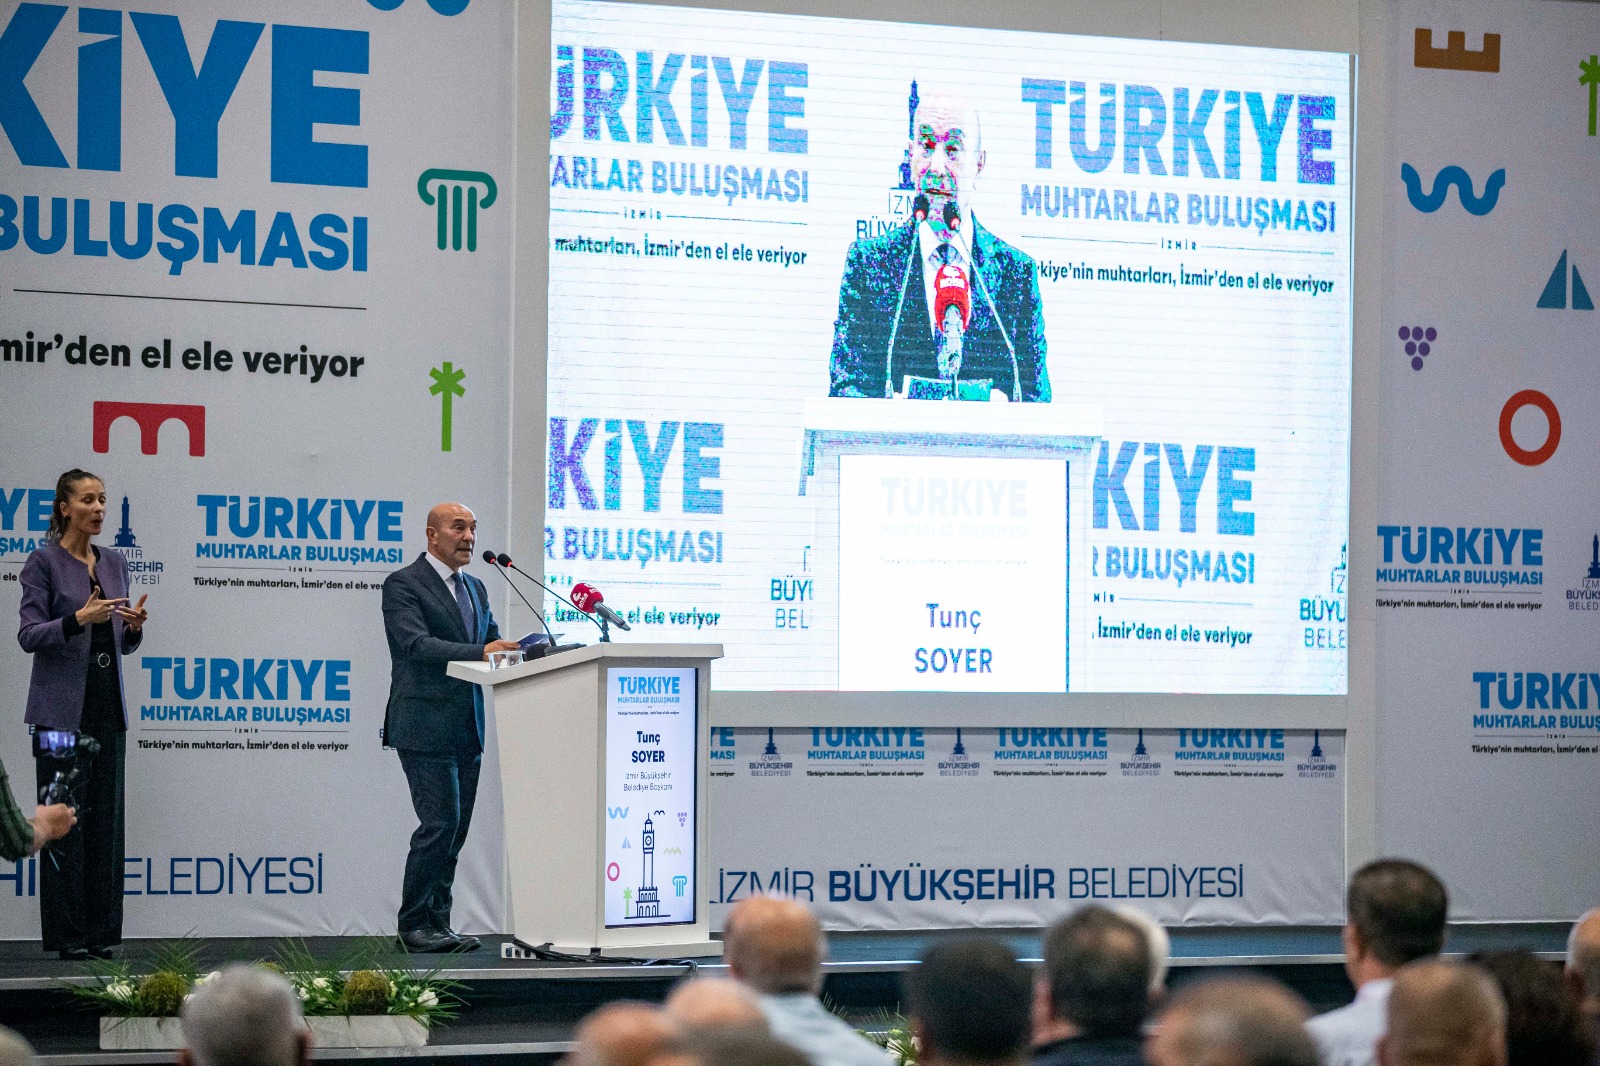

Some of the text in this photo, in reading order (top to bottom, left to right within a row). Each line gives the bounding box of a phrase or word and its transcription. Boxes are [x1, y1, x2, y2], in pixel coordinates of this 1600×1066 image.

[1021, 77, 1336, 185] TÜRKİYE
[550, 155, 808, 206] ARLAR BULUŞMASI
[1021, 184, 1336, 237] MUHTARLAR BULUŞMASI
[716, 243, 728, 260] el
[732, 244, 753, 261] ele
[757, 245, 807, 268] veriyor
[1161, 237, 1197, 250] İZMİR
[1097, 264, 1177, 287] muhtarları,
[1180, 264, 1243, 288] İzmir'den
[1247, 272, 1258, 288] el
[1263, 273, 1283, 290] ele
[1286, 274, 1334, 296] veriyor
[141, 339, 172, 370] el
[181, 341, 233, 374] ele
[243, 345, 364, 384] veriyor
[549, 416, 724, 514] KİYE
[196, 494, 403, 542] TÜRKİYE
[196, 543, 403, 565] MUHTARLAR BULUŞMASI
[564, 526, 723, 569] BULUŞMASI
[1377, 525, 1543, 566] TÜRKİYE
[1106, 545, 1255, 588] BULUŞMASI
[1376, 568, 1543, 588] MUHTARLAR BULUŞMASI
[193, 577, 245, 588] Türkiye'nin
[246, 577, 299, 589] muhtarları,
[301, 577, 343, 589] İzmir'den
[345, 580, 353, 589] el
[355, 581, 368, 590] ele
[1416, 599, 1459, 609] muhtarları,
[1460, 599, 1494, 609] İzmir'den
[1496, 601, 1503, 609] el
[1504, 601, 1515, 609] ele
[1516, 602, 1542, 611] veriyor
[926, 603, 981, 634] Tunç
[1098, 616, 1253, 648] İzmir'den el ele veriyor
[914, 647, 993, 674] SOYER
[141, 656, 351, 701] TÜRKİYE
[617, 676, 680, 694] TÜRKİYE
[141, 705, 350, 726] MUHTARLAR BULUŞMASI
[1473, 714, 1556, 729] MUHTARLAR
[138, 739, 349, 752] Türkiye'nin muhtarları, İzmir'den el ele veriyor
[637, 731, 661, 745] Tunç
[1472, 743, 1598, 754] Türkiye'nin muhtarları, İzmir'den el
[631, 750, 665, 763] SOYER
[807, 750, 924, 761] MUHTARLAR BULUŞMASI
[994, 750, 1107, 761] MUHTARLAR BULUŞMASI
[1175, 751, 1284, 762] MUHTARLAR BULUŞMASI
[124, 852, 323, 896] ELEDİYESİ
[828, 863, 1056, 904] BÜYÜKŞEHİR
[1068, 863, 1244, 899] BELEDİYESİ
